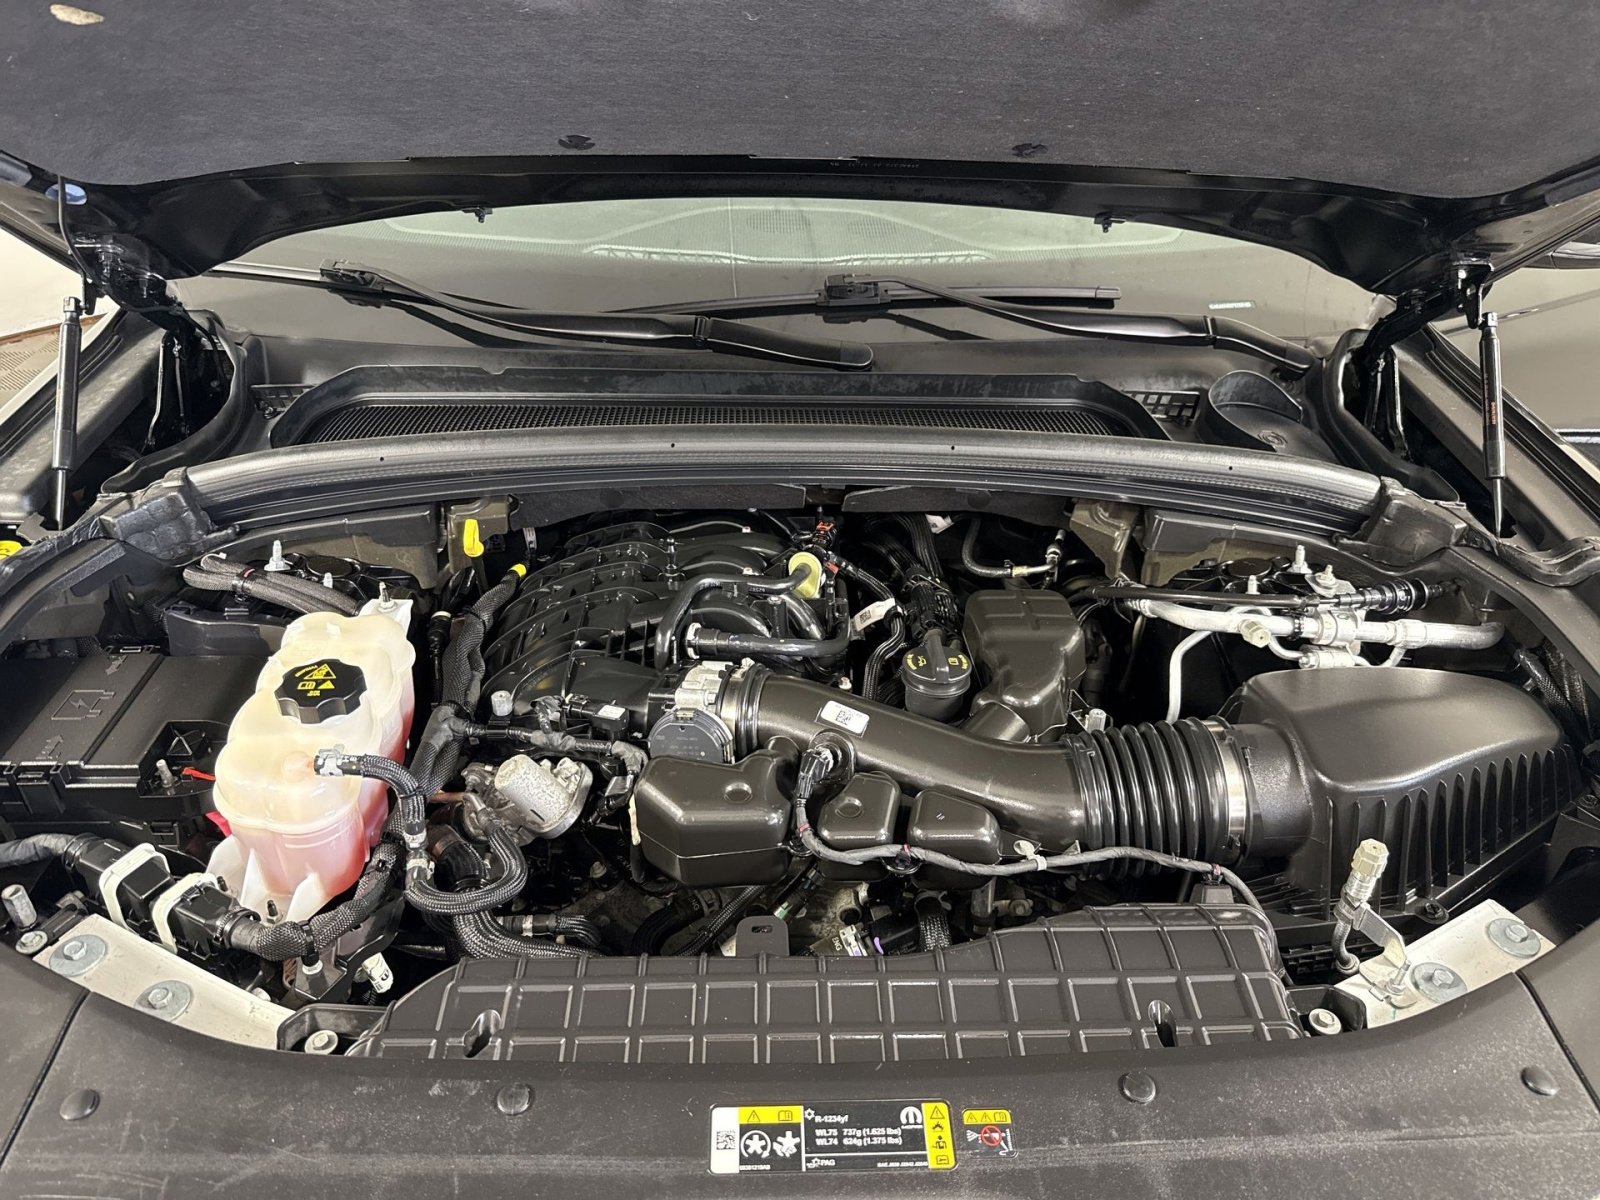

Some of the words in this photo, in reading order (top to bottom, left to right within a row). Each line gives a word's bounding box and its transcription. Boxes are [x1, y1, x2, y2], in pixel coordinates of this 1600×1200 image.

[832, 937, 843, 951] ENG
[815, 1115, 848, 1123] R-1234yf
[842, 1128, 861, 1137] 737g
[843, 1138, 862, 1146] 624g
